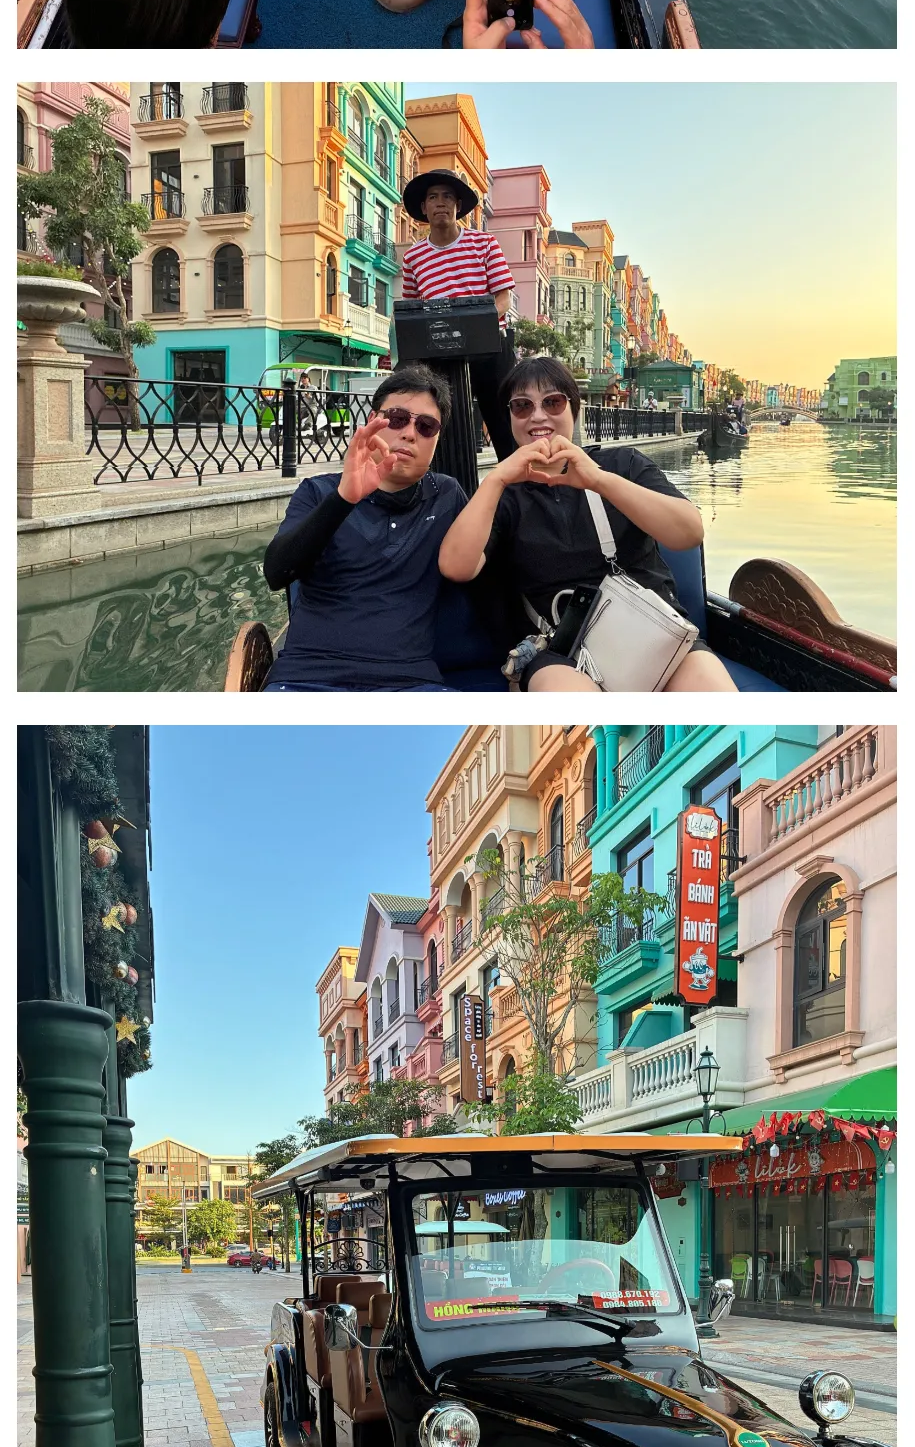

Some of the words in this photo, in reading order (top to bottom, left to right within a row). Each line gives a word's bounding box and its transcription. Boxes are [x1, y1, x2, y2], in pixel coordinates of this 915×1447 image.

[691, 843, 712, 870] TRÀ
[688, 878, 714, 905] BÁNH
[683, 915, 697, 942] ĂN
[464, 997, 472, 1042] Space
[470, 1043, 478, 1069] for
[476, 1065, 484, 1099] rest
